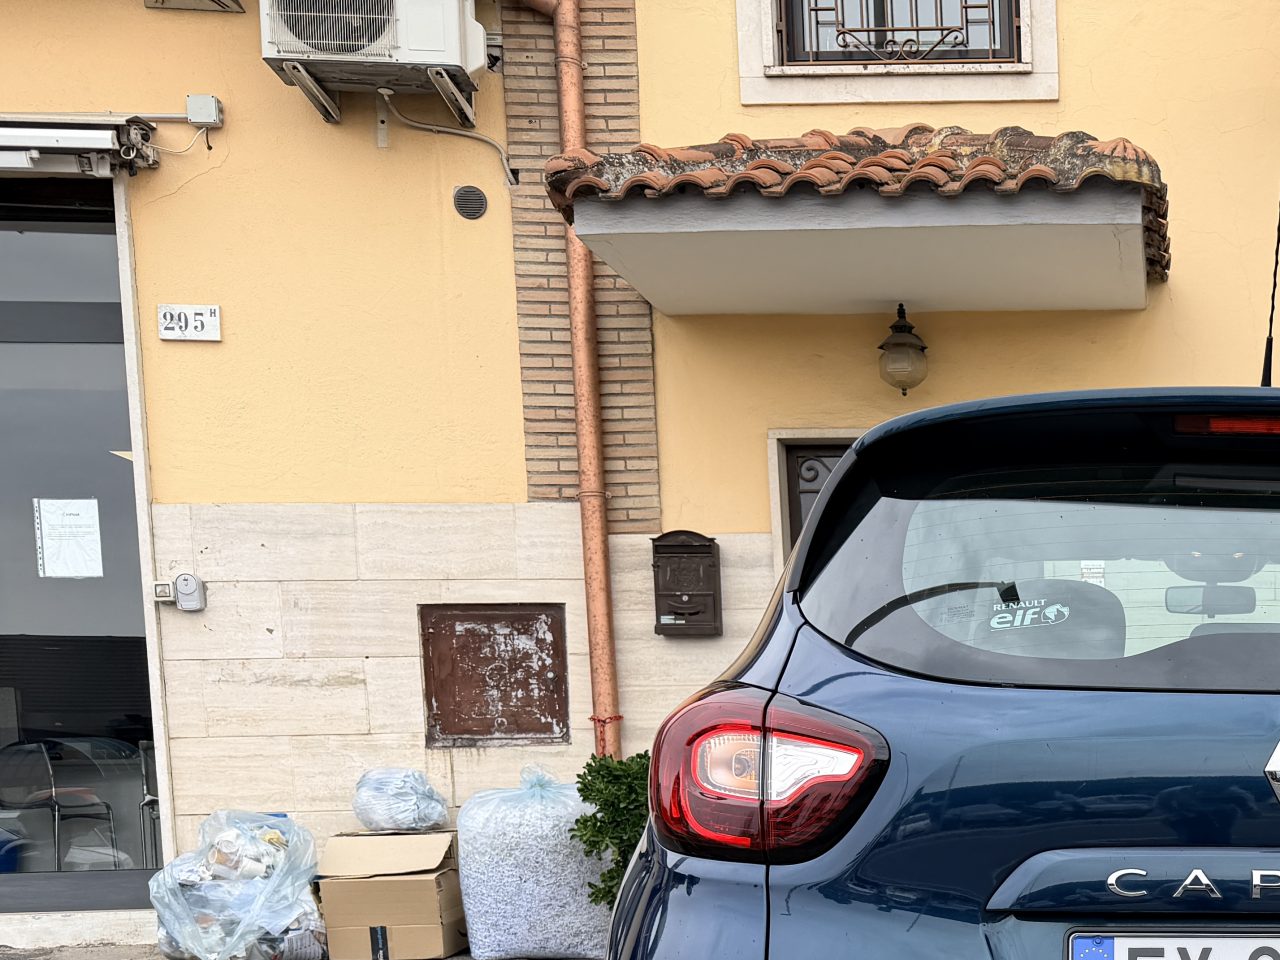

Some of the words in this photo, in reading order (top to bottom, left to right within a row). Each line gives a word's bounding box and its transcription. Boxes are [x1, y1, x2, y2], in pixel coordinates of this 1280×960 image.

[162, 311, 205, 333] 295
[993, 598, 1047, 611] RENAULT
[990, 607, 1040, 628] elf
